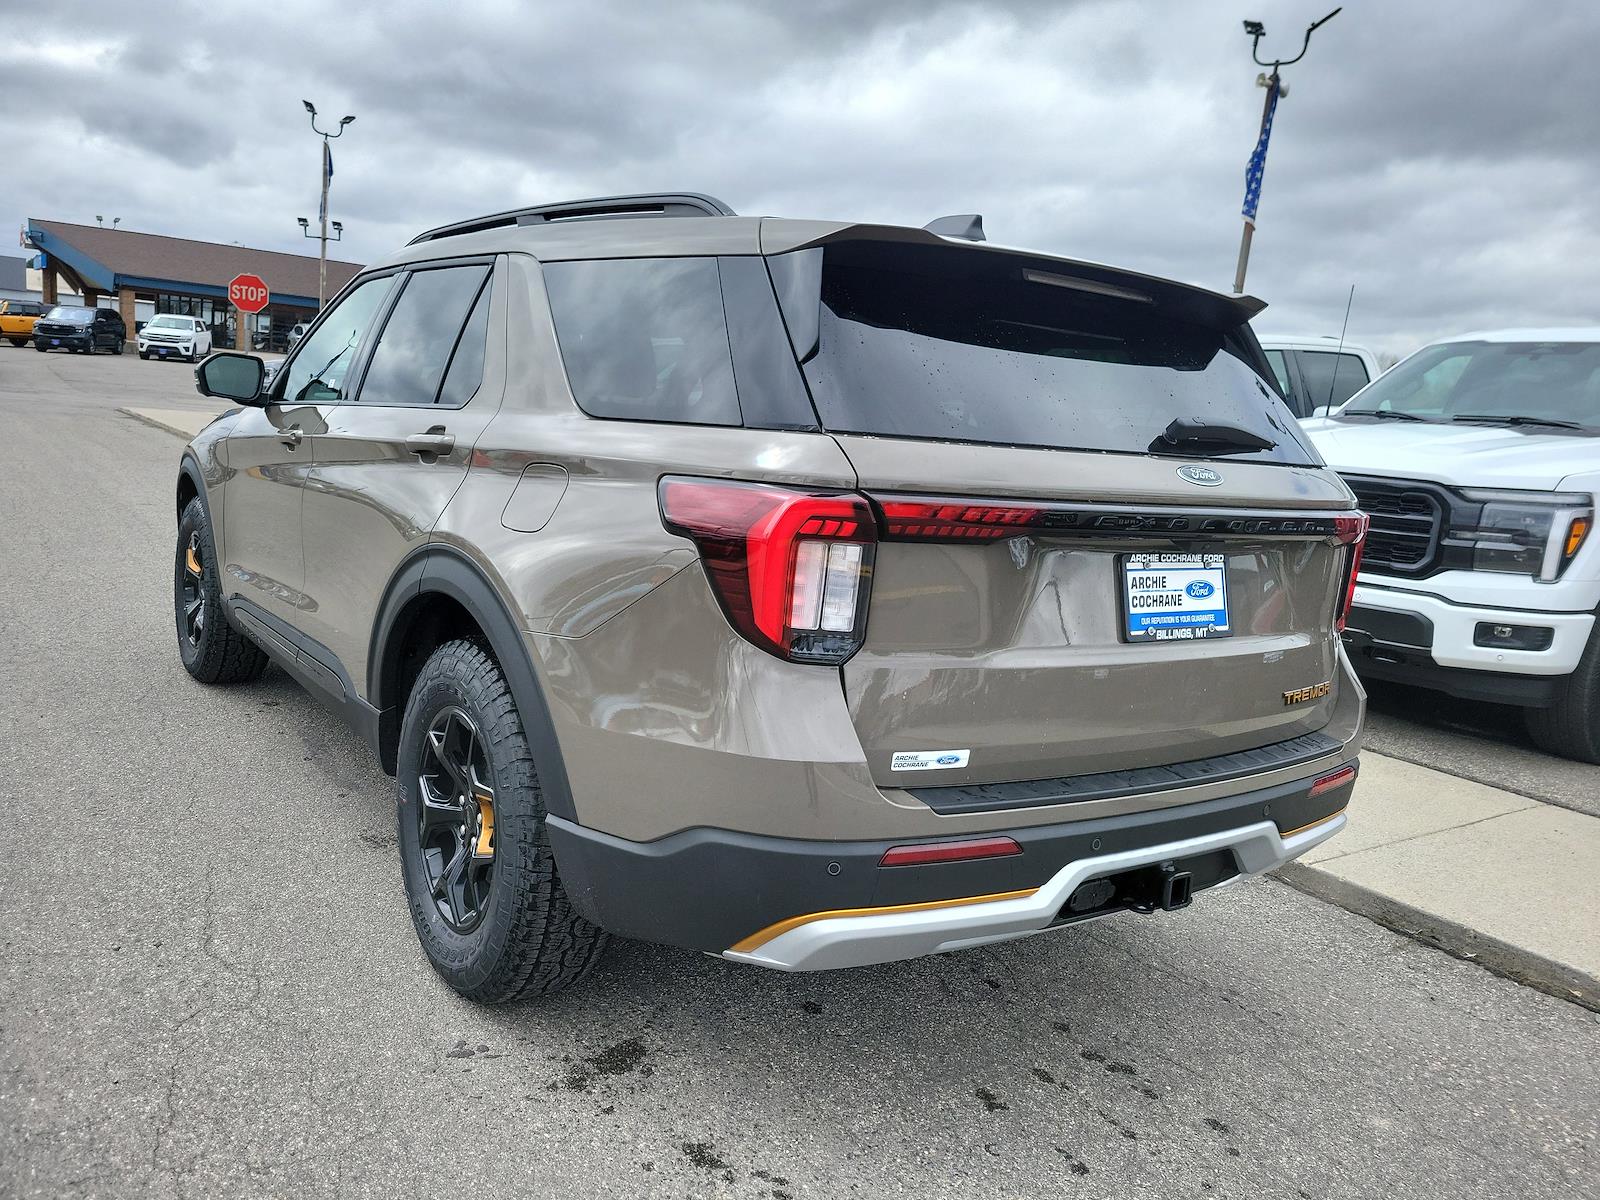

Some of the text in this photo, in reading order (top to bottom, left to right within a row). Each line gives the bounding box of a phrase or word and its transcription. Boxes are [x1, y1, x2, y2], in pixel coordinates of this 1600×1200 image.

[231, 284, 267, 302] STOP
[1130, 553, 1224, 562] ARCHIE COCHRANE FORD
[1131, 576, 1167, 589] ARCHIE
[1131, 594, 1183, 608] COCHRANE
[1156, 628, 1208, 640] BILLINGS, MT
[1282, 681, 1331, 706] TREMOR
